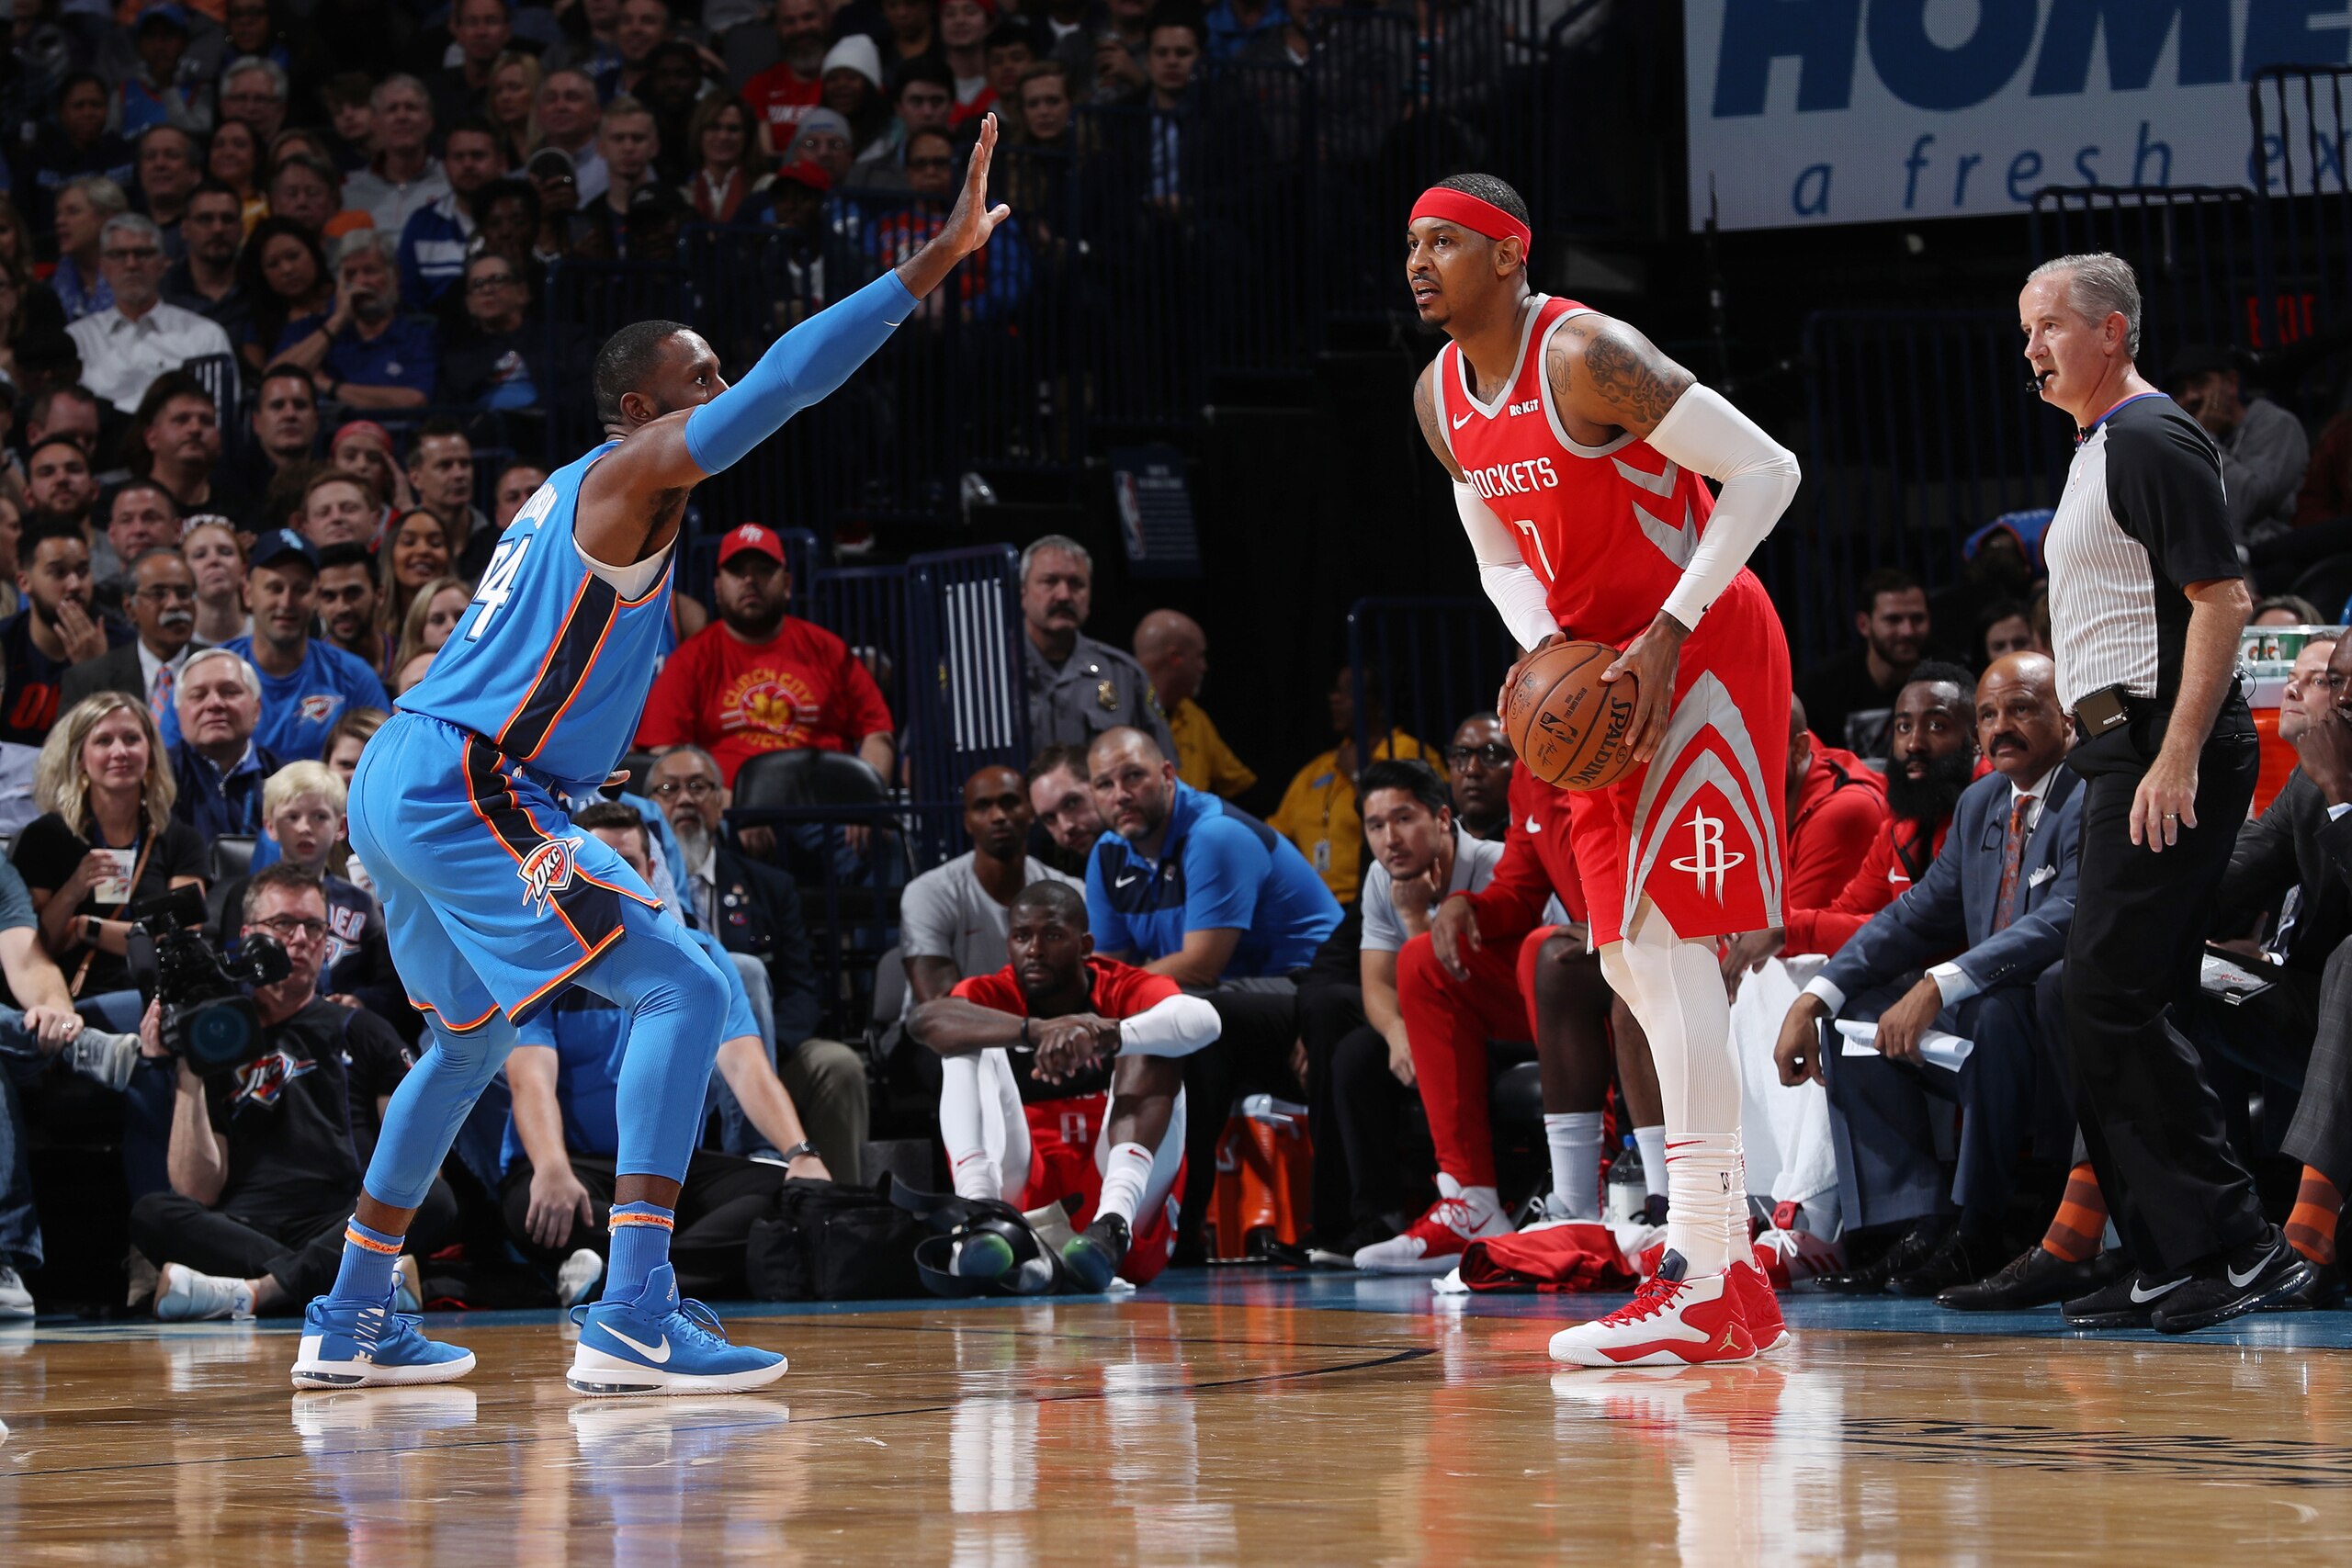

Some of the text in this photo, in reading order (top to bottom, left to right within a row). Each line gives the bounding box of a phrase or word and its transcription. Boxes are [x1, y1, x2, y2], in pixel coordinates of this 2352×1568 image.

[1792, 163, 1833, 217] a
[1904, 120, 2172, 209] fresh
[1461, 457, 1560, 501] ROCKETS
[1513, 518, 1556, 583] 7
[1564, 695, 1633, 787] SPALDING
[532, 847, 561, 897] OKC
